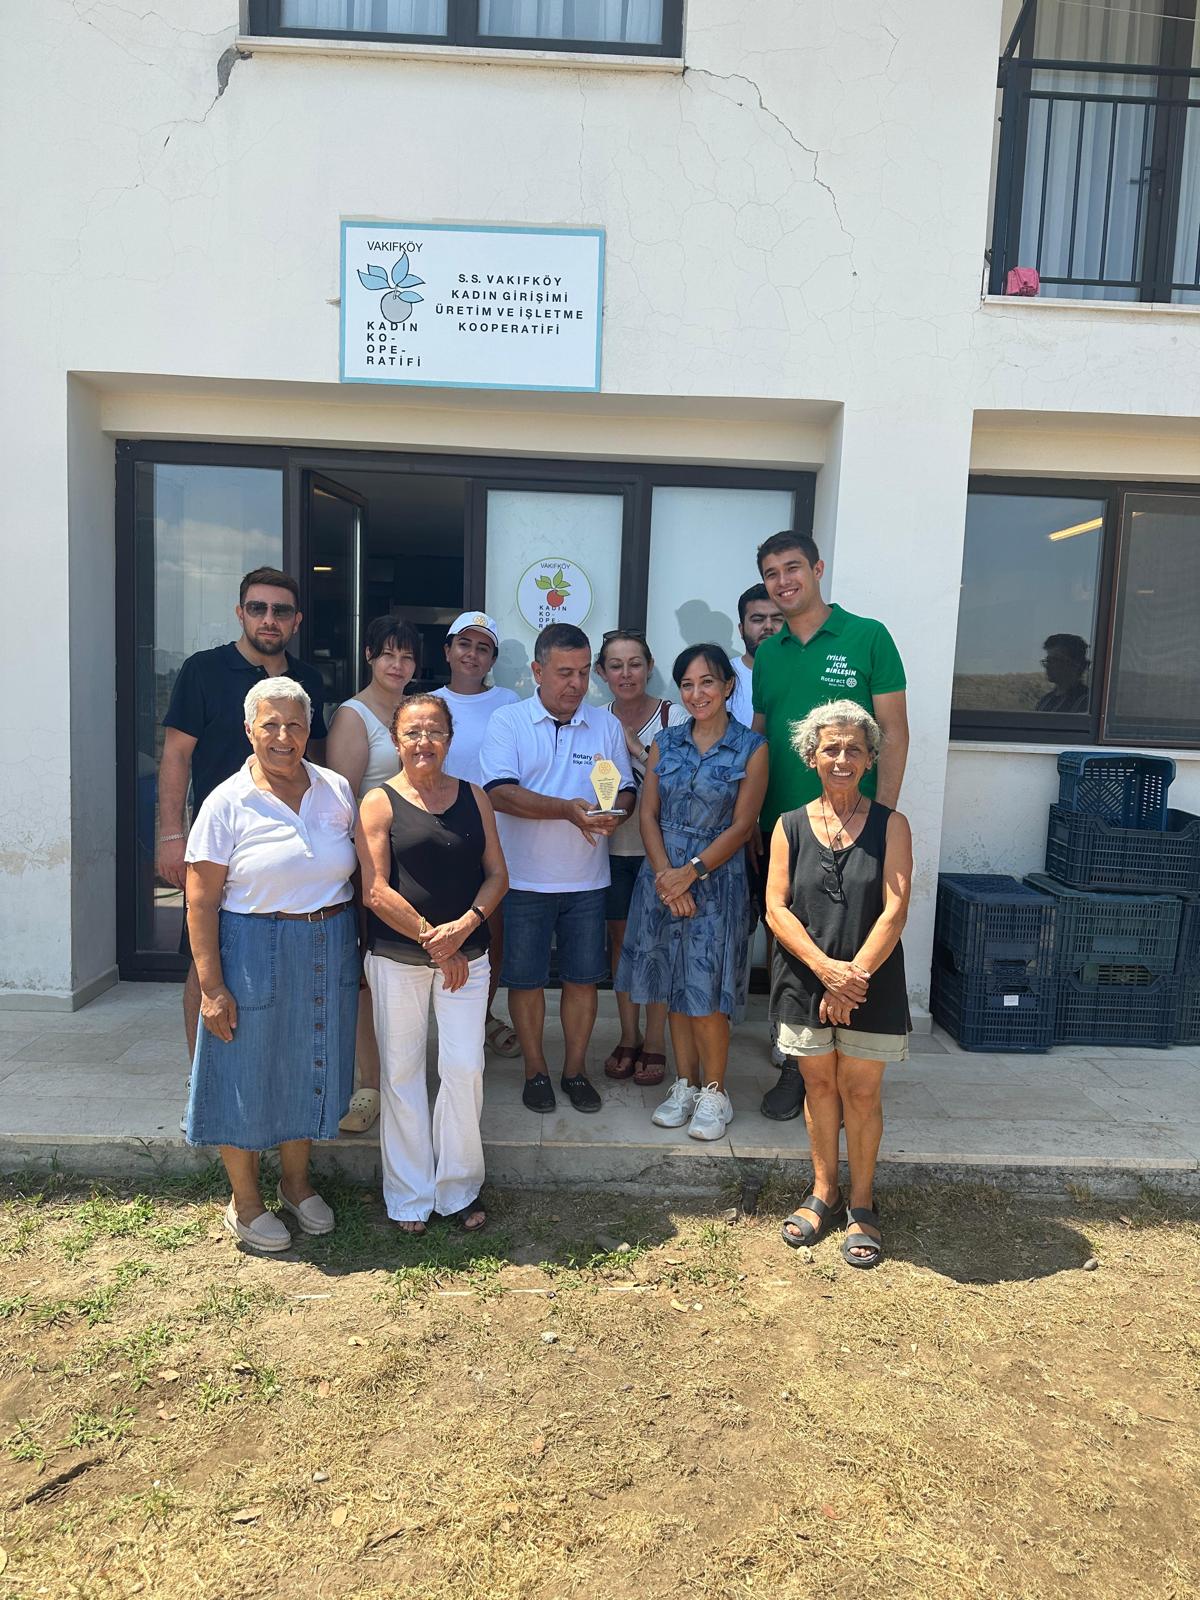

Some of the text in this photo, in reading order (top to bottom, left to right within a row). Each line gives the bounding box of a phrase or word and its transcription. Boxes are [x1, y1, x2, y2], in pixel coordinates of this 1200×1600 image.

[367, 240, 423, 252] VAKIFKÖY
[458, 274, 562, 286] S.S. VAKIFKÖY
[451, 290, 568, 304] KADIN GİRİŞİMİ
[435, 303, 583, 320] ÜRETİM VE İŞLETME
[367, 321, 418, 332] KADIN
[458, 323, 560, 335] KOOPERATİFİ
[367, 333, 396, 342] KO-
[366, 344, 406, 354] OPE-
[366, 356, 421, 367] RATİFİ
[540, 562, 571, 570] VAKIFKÖY
[820, 675, 846, 684] Rotaract
[572, 753, 593, 761] Rotary
